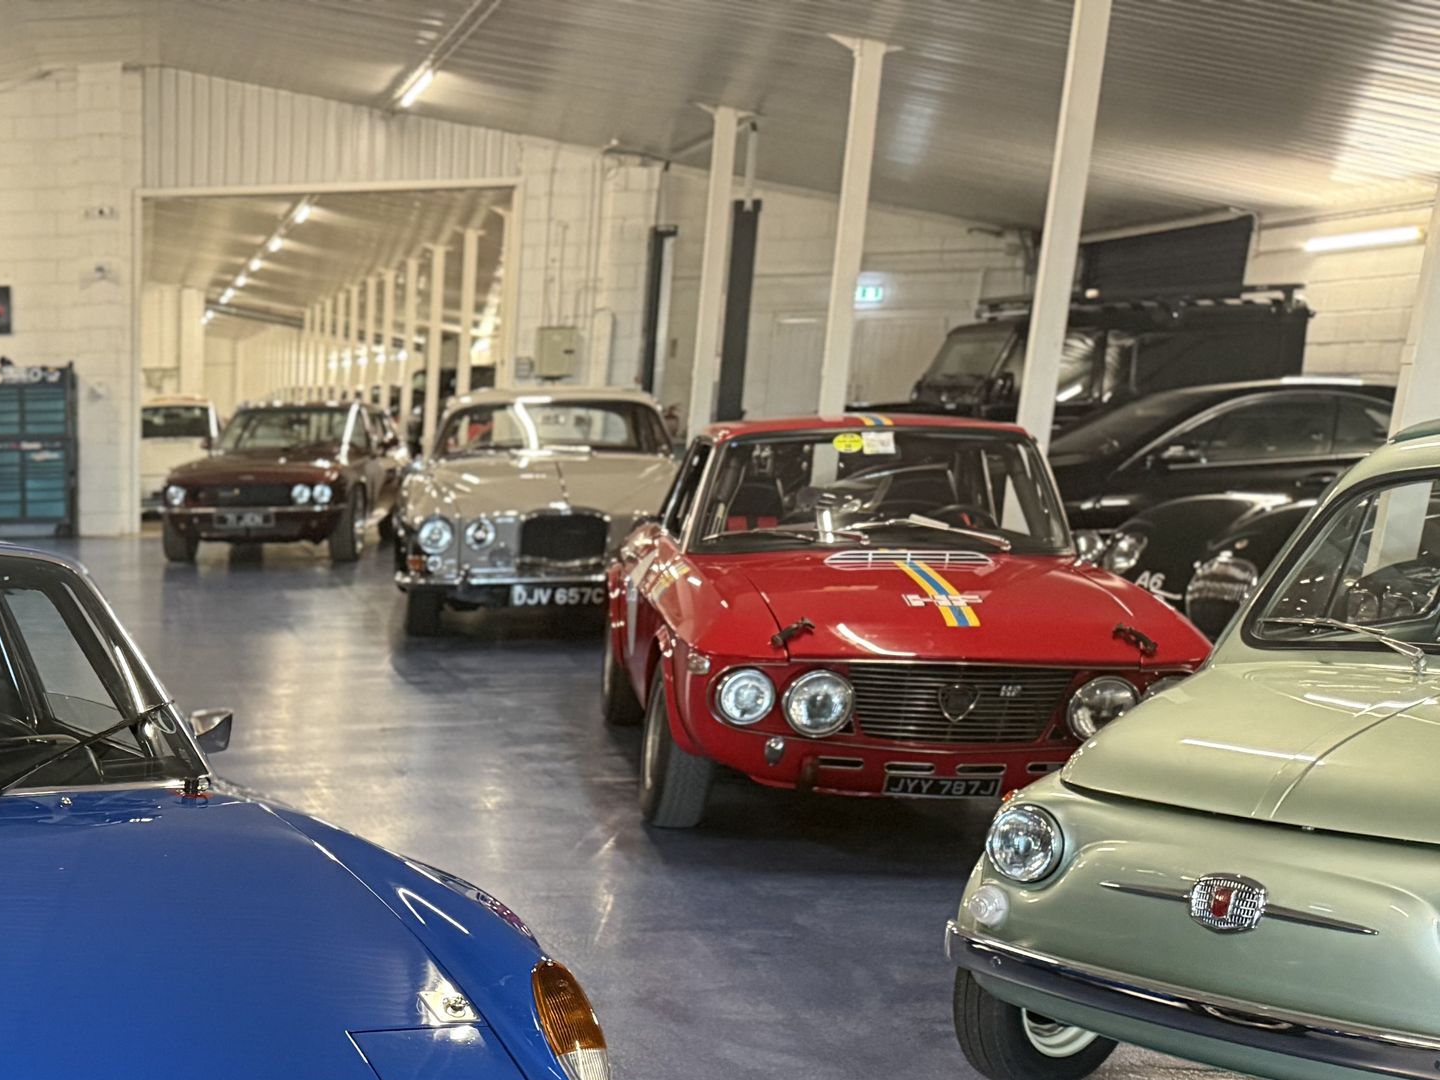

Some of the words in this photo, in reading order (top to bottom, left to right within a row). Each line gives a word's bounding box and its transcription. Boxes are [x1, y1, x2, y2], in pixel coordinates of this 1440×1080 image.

[512, 585, 551, 606] DJV
[554, 587, 604, 605] 657C
[890, 778, 933, 793] JYY
[939, 780, 995, 795] 787J
